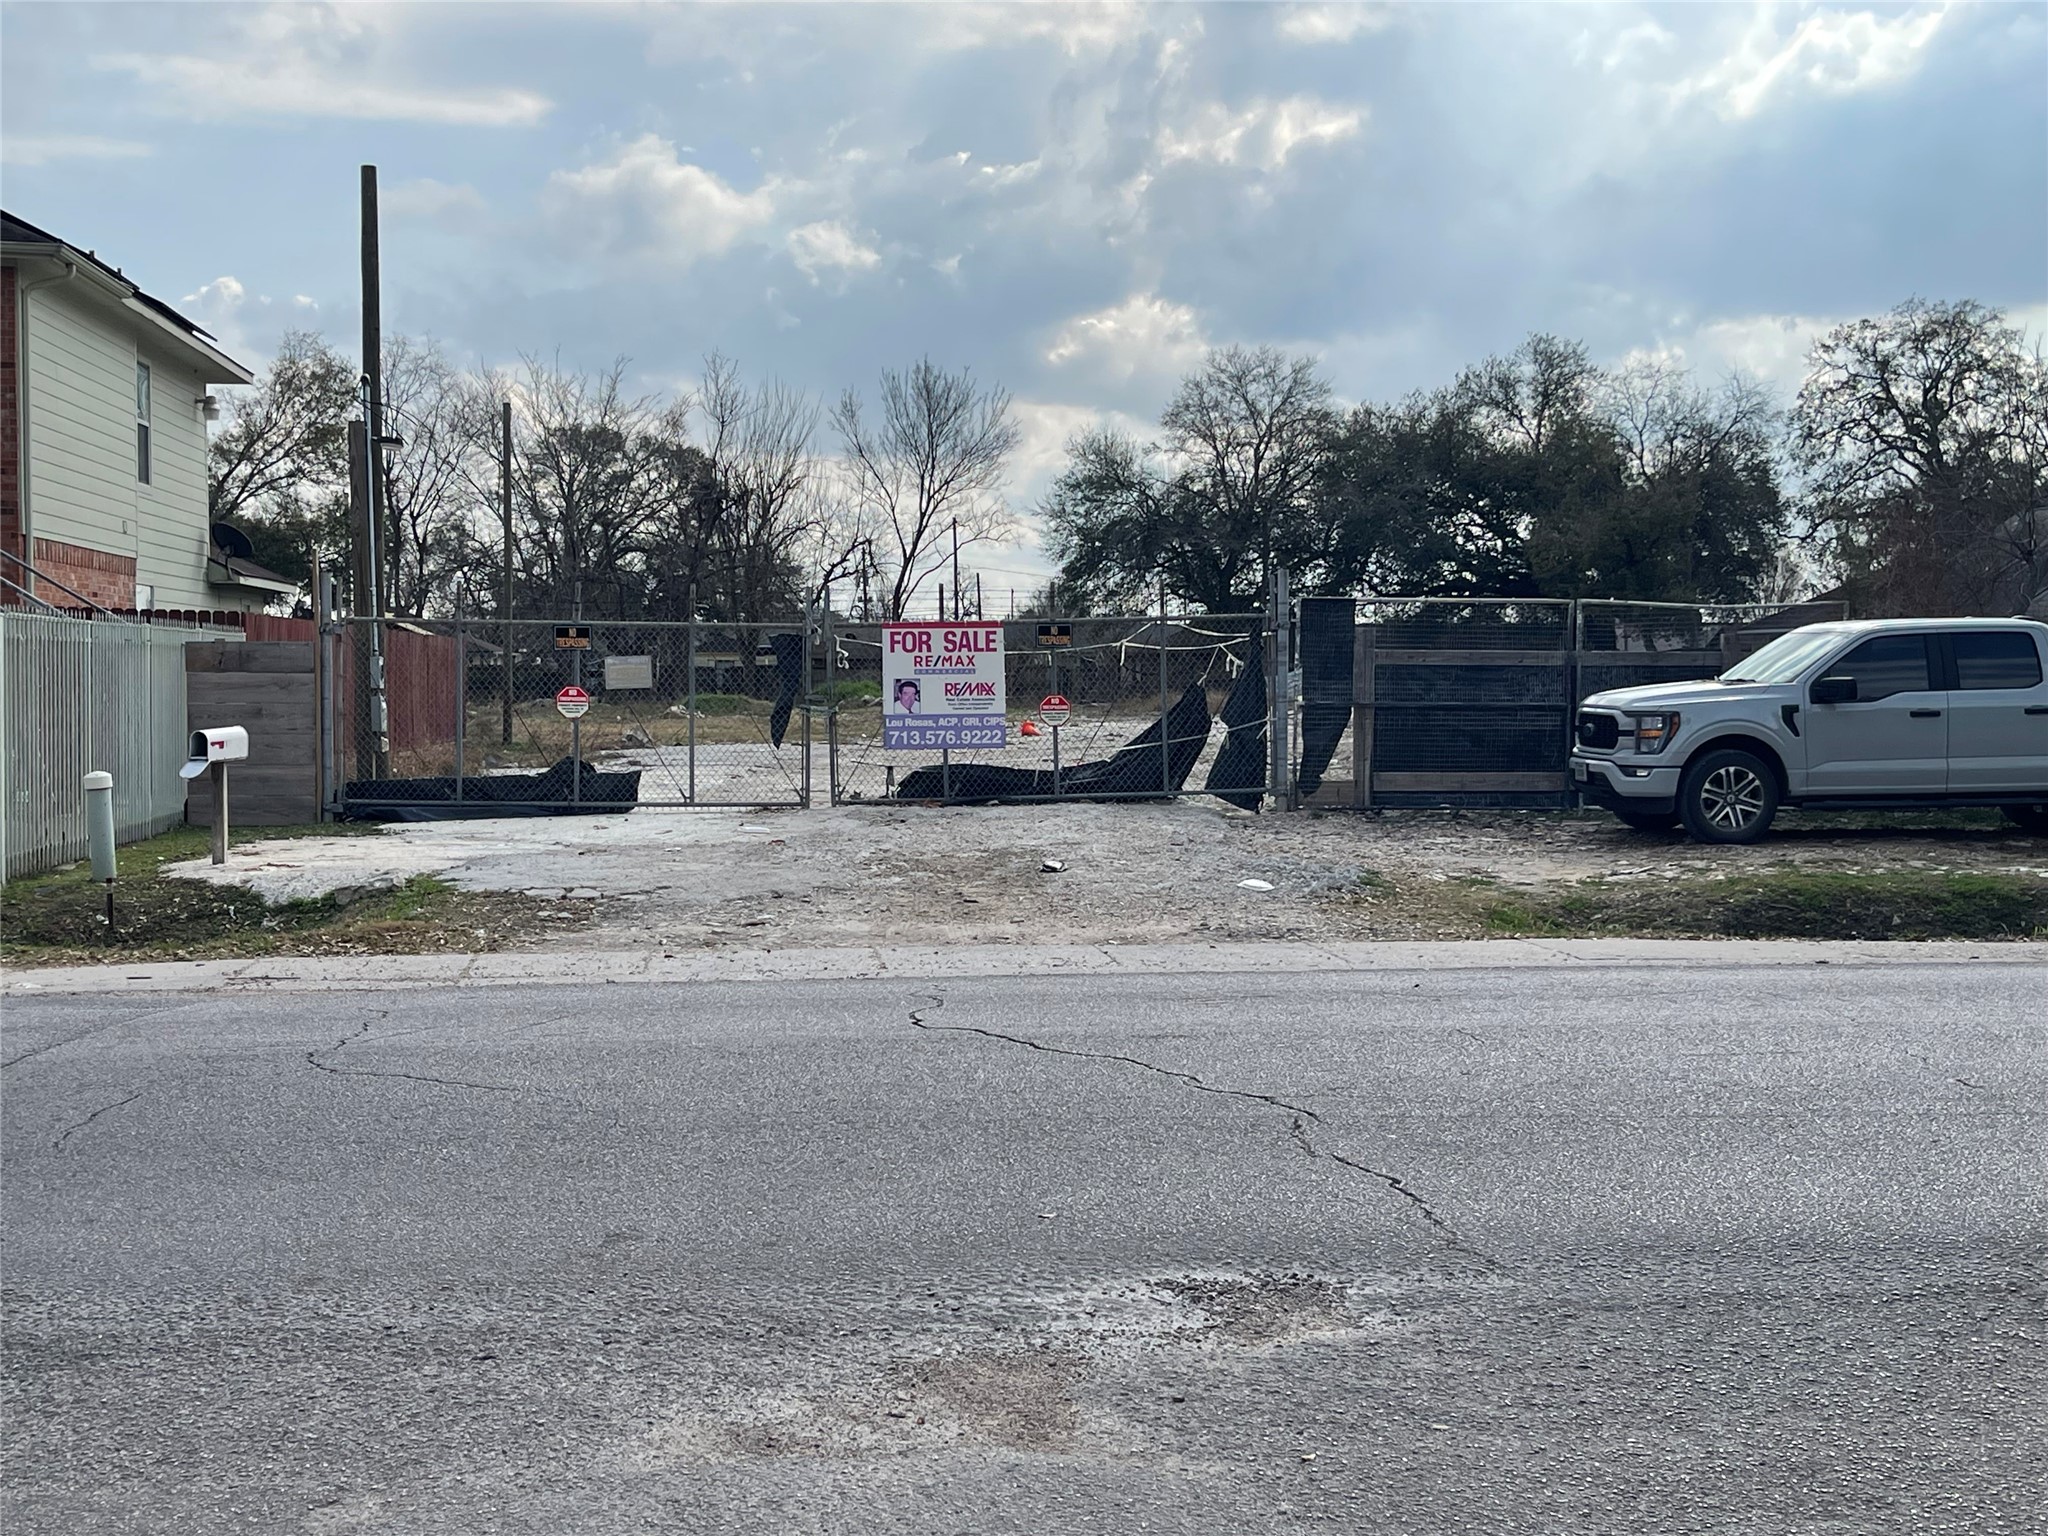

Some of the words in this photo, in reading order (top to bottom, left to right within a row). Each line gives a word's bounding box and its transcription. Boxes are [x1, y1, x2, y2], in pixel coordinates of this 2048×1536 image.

[889, 631, 932, 653] FOR
[943, 630, 998, 653] SALE
[914, 655, 976, 667] RE/MAX
[944, 681, 996, 697] RE/MAX
[885, 718, 903, 727] Lou
[905, 718, 936, 727] Rosas,
[938, 717, 961, 727] ACP,
[962, 716, 982, 727] GRI,
[984, 716, 1005, 726] CIPS
[888, 730, 1002, 745] 713.576.9222
